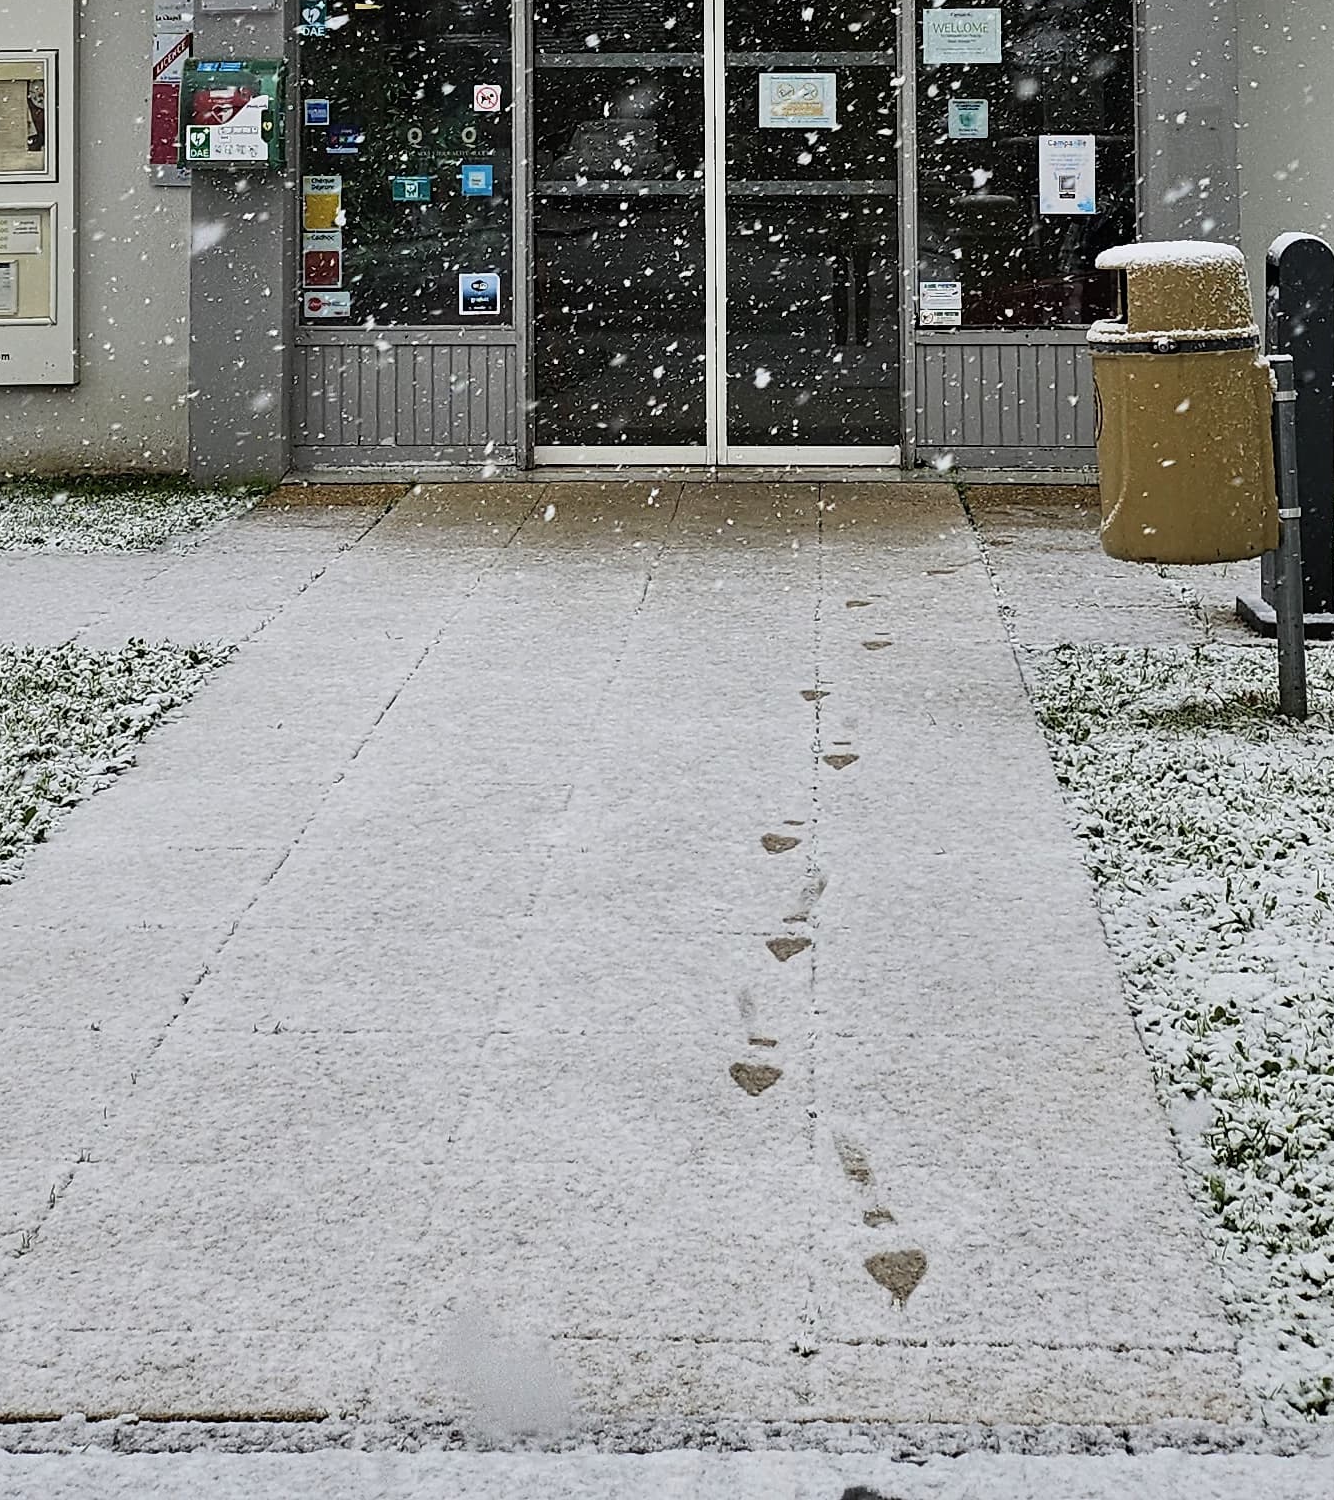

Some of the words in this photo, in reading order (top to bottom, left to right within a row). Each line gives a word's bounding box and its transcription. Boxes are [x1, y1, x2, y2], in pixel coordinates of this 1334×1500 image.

[302, 27, 326, 37] DAE
[156, 40, 187, 75] LICENCE
[1047, 139, 1087, 149] Campae
[190, 148, 211, 157] DAE
